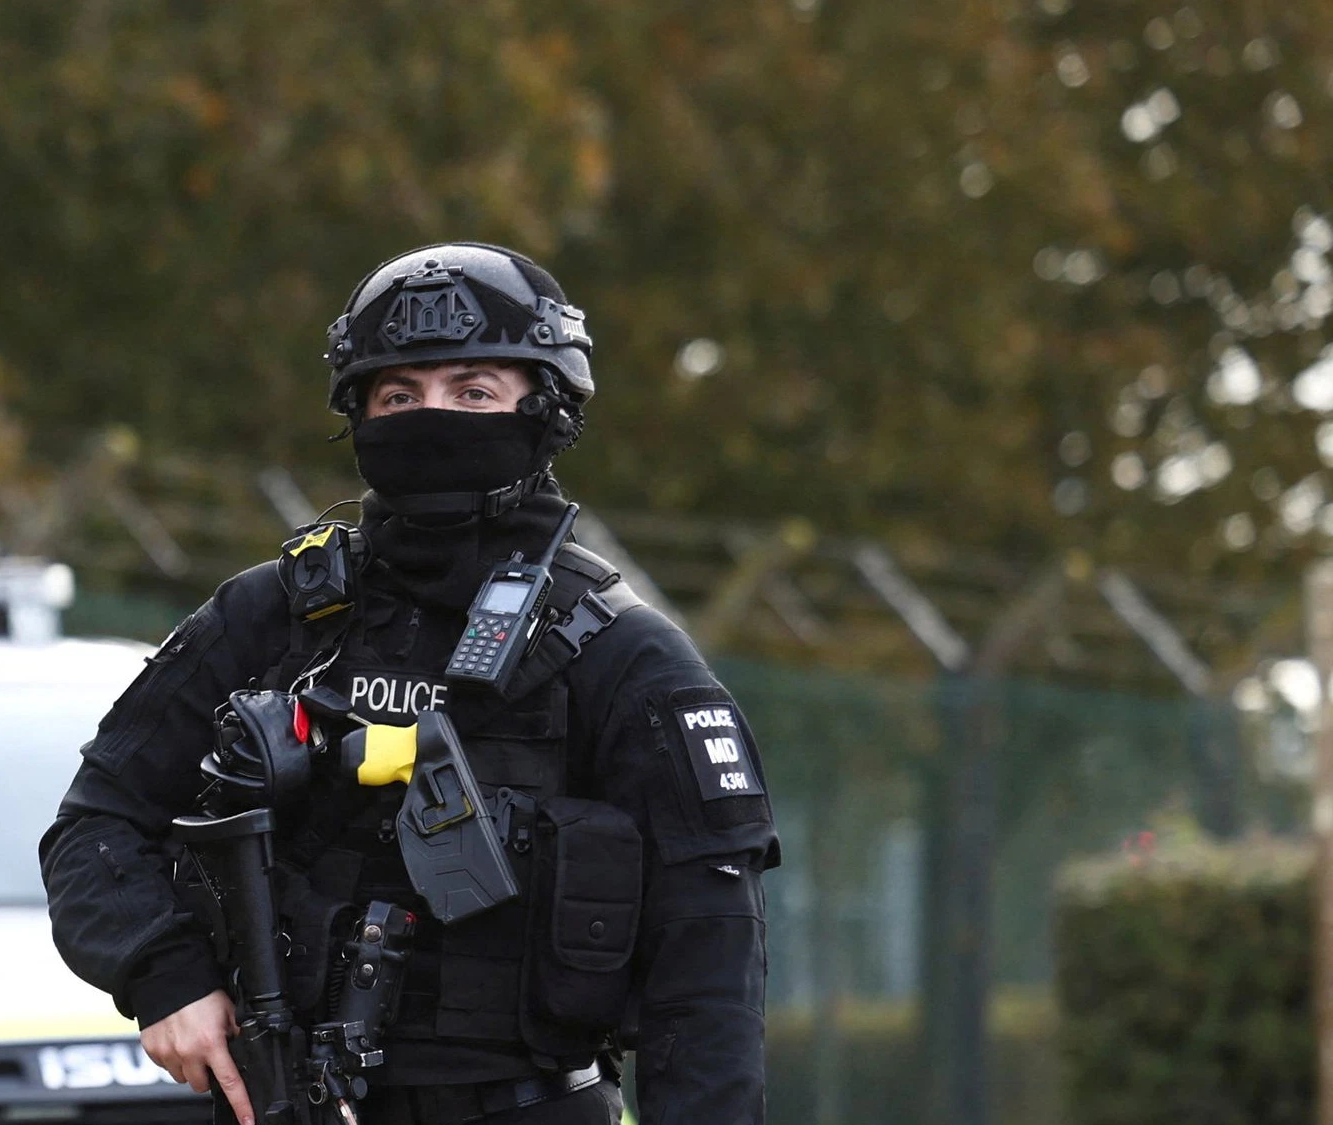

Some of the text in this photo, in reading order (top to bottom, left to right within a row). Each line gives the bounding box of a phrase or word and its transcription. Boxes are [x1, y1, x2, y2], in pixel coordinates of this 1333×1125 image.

[351, 677, 448, 715] POLICE
[684, 710, 736, 730] POLICE
[704, 738, 739, 763] MD
[39, 1043, 179, 1089] ISU
